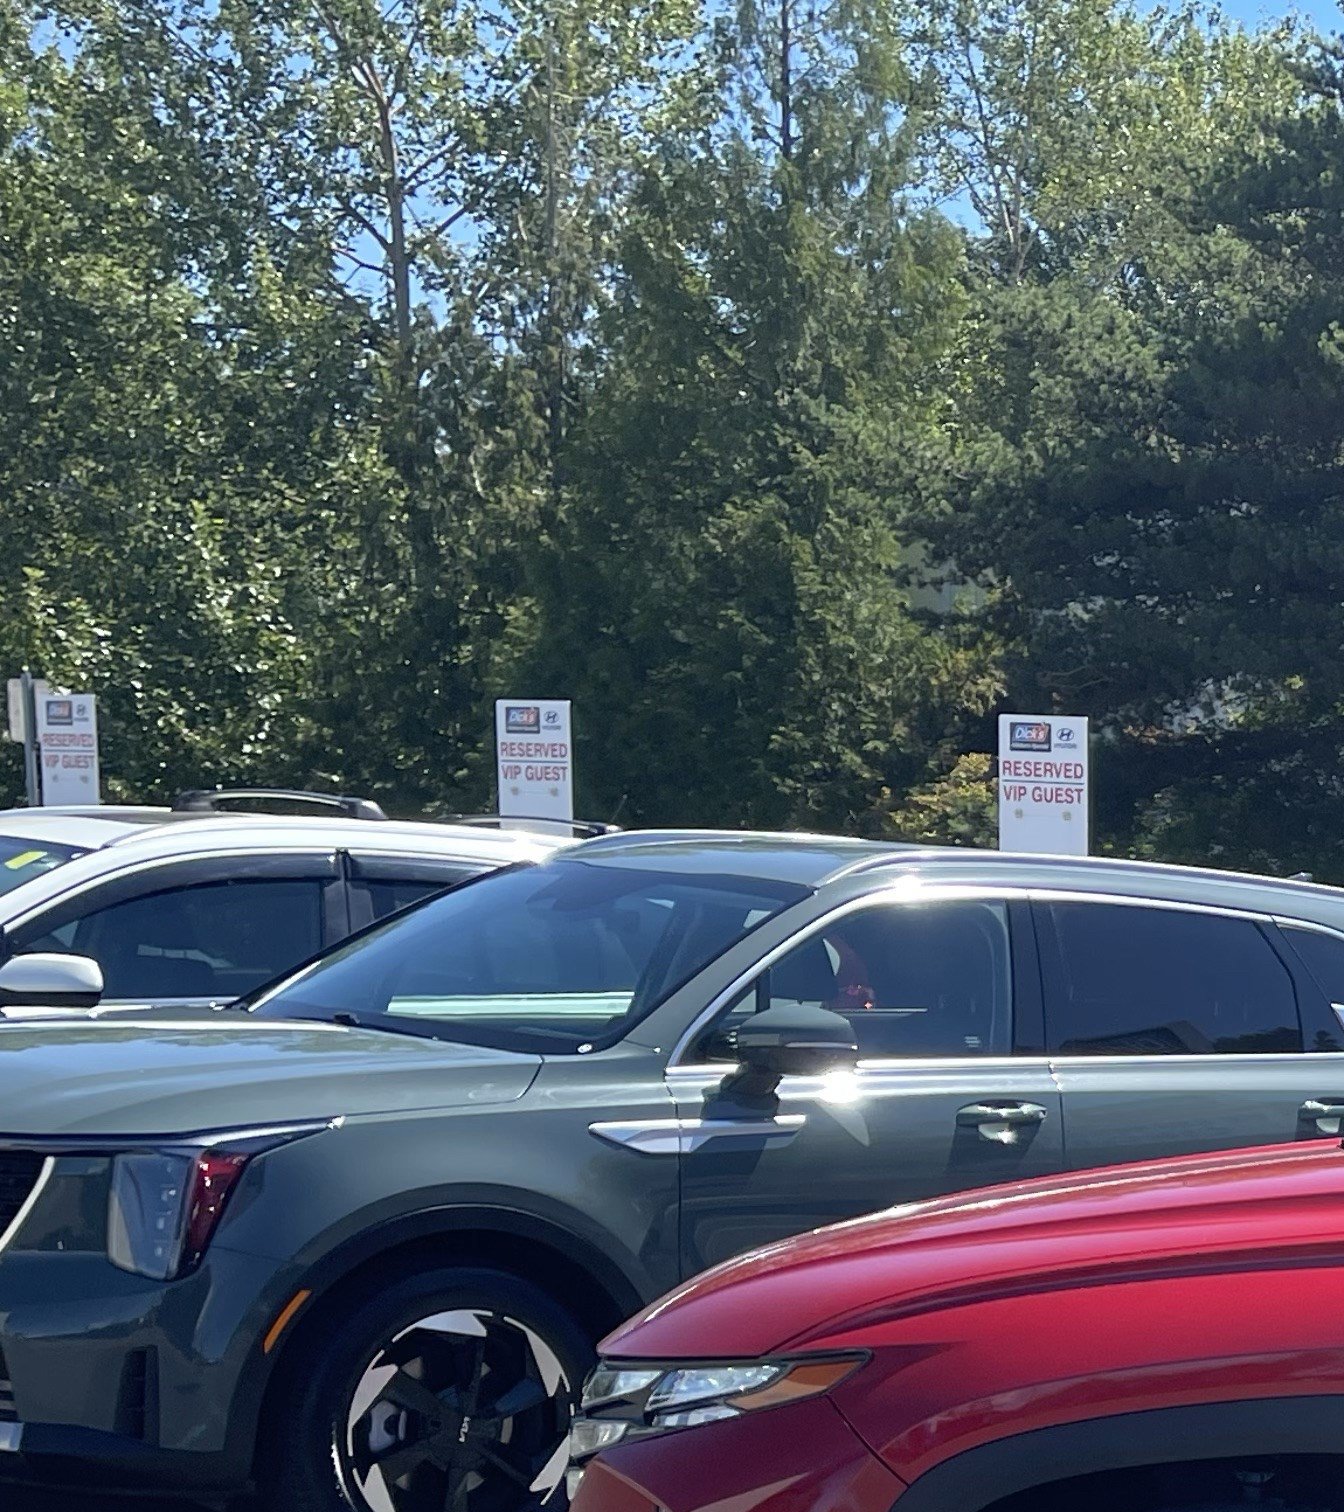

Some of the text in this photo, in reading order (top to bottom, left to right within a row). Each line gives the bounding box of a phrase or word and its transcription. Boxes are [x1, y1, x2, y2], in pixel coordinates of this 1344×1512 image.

[500, 742, 568, 758] RESERVED
[501, 764, 569, 782] VIP GUEST
[1002, 760, 1084, 779] RESERVED
[1003, 785, 1084, 804] VIP GUEST
